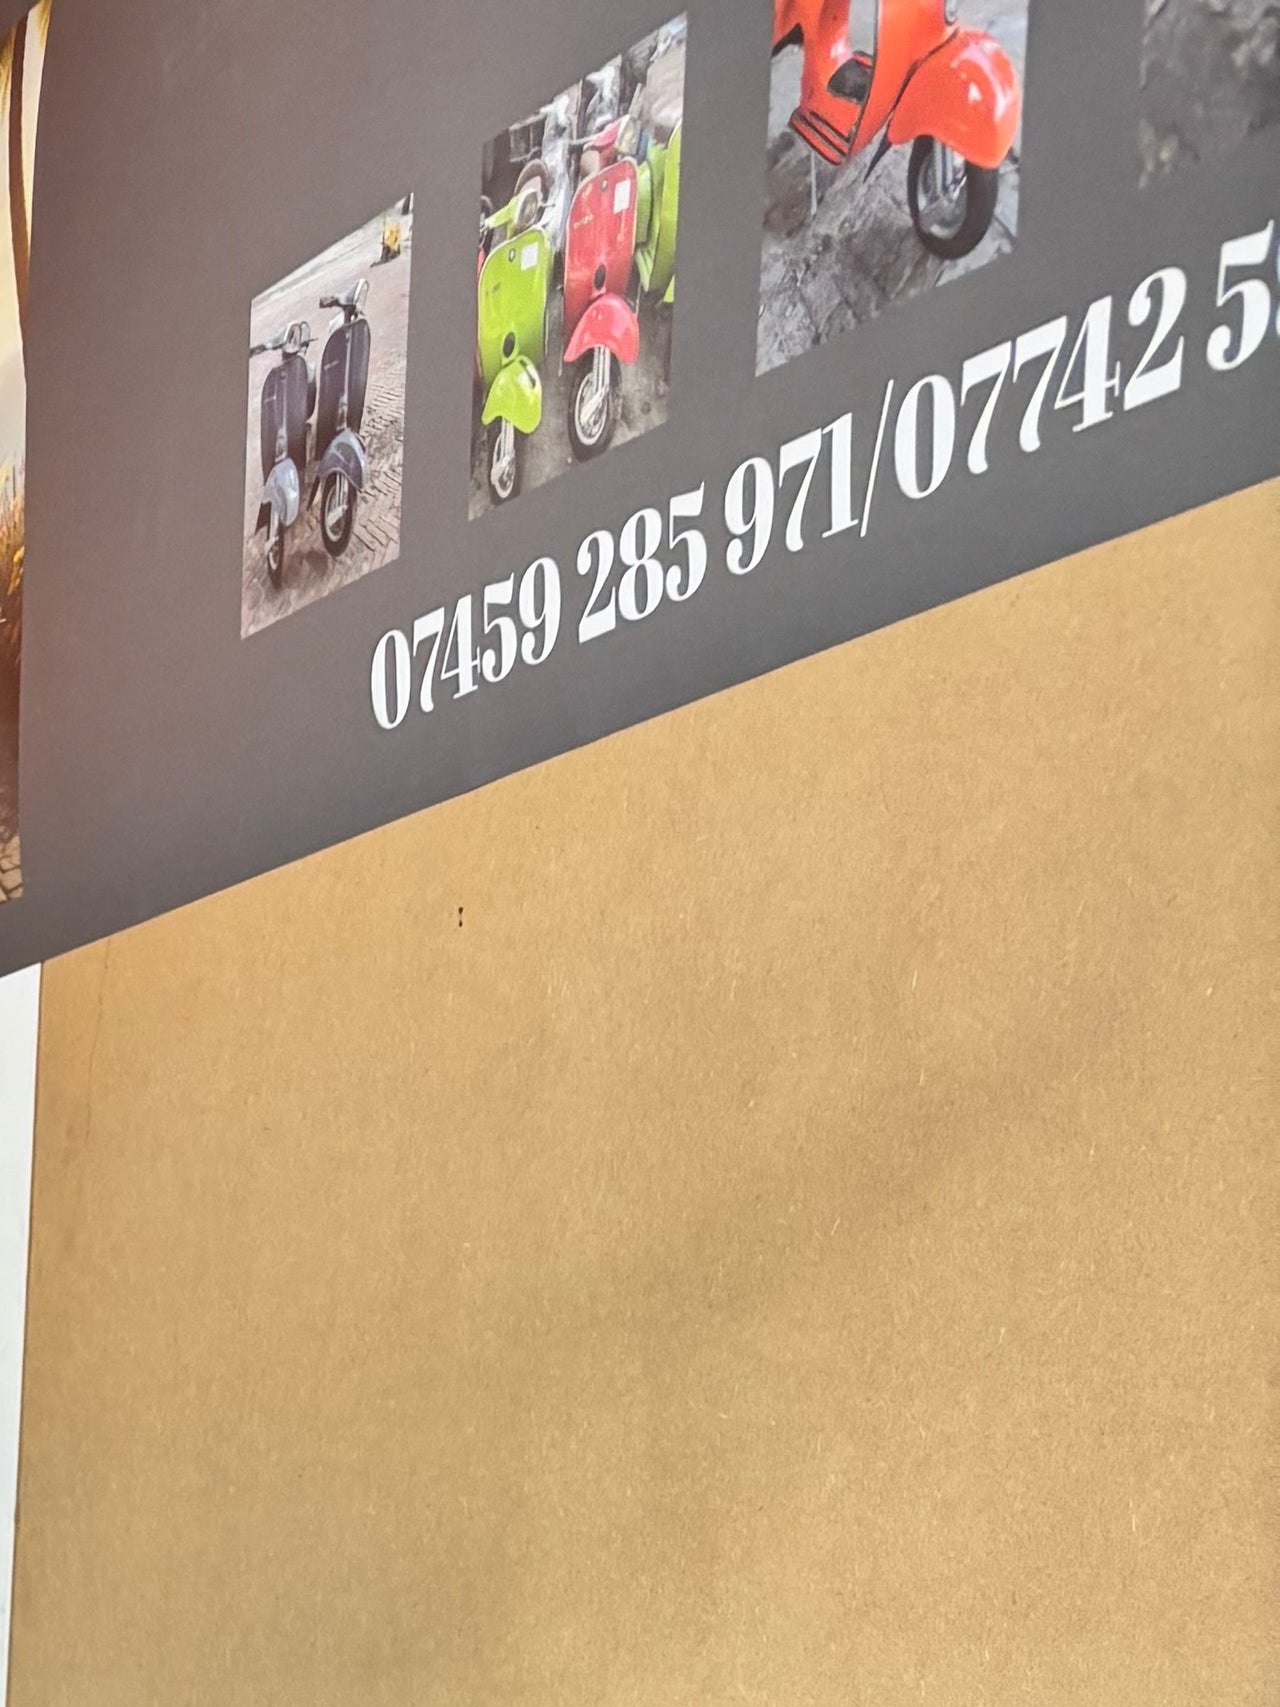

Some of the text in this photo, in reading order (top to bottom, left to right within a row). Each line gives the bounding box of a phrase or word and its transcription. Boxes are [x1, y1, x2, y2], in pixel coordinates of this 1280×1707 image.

[370, 556, 561, 730] 07459
[577, 481, 707, 644] 285
[1206, 219, 1280, 372] 5
